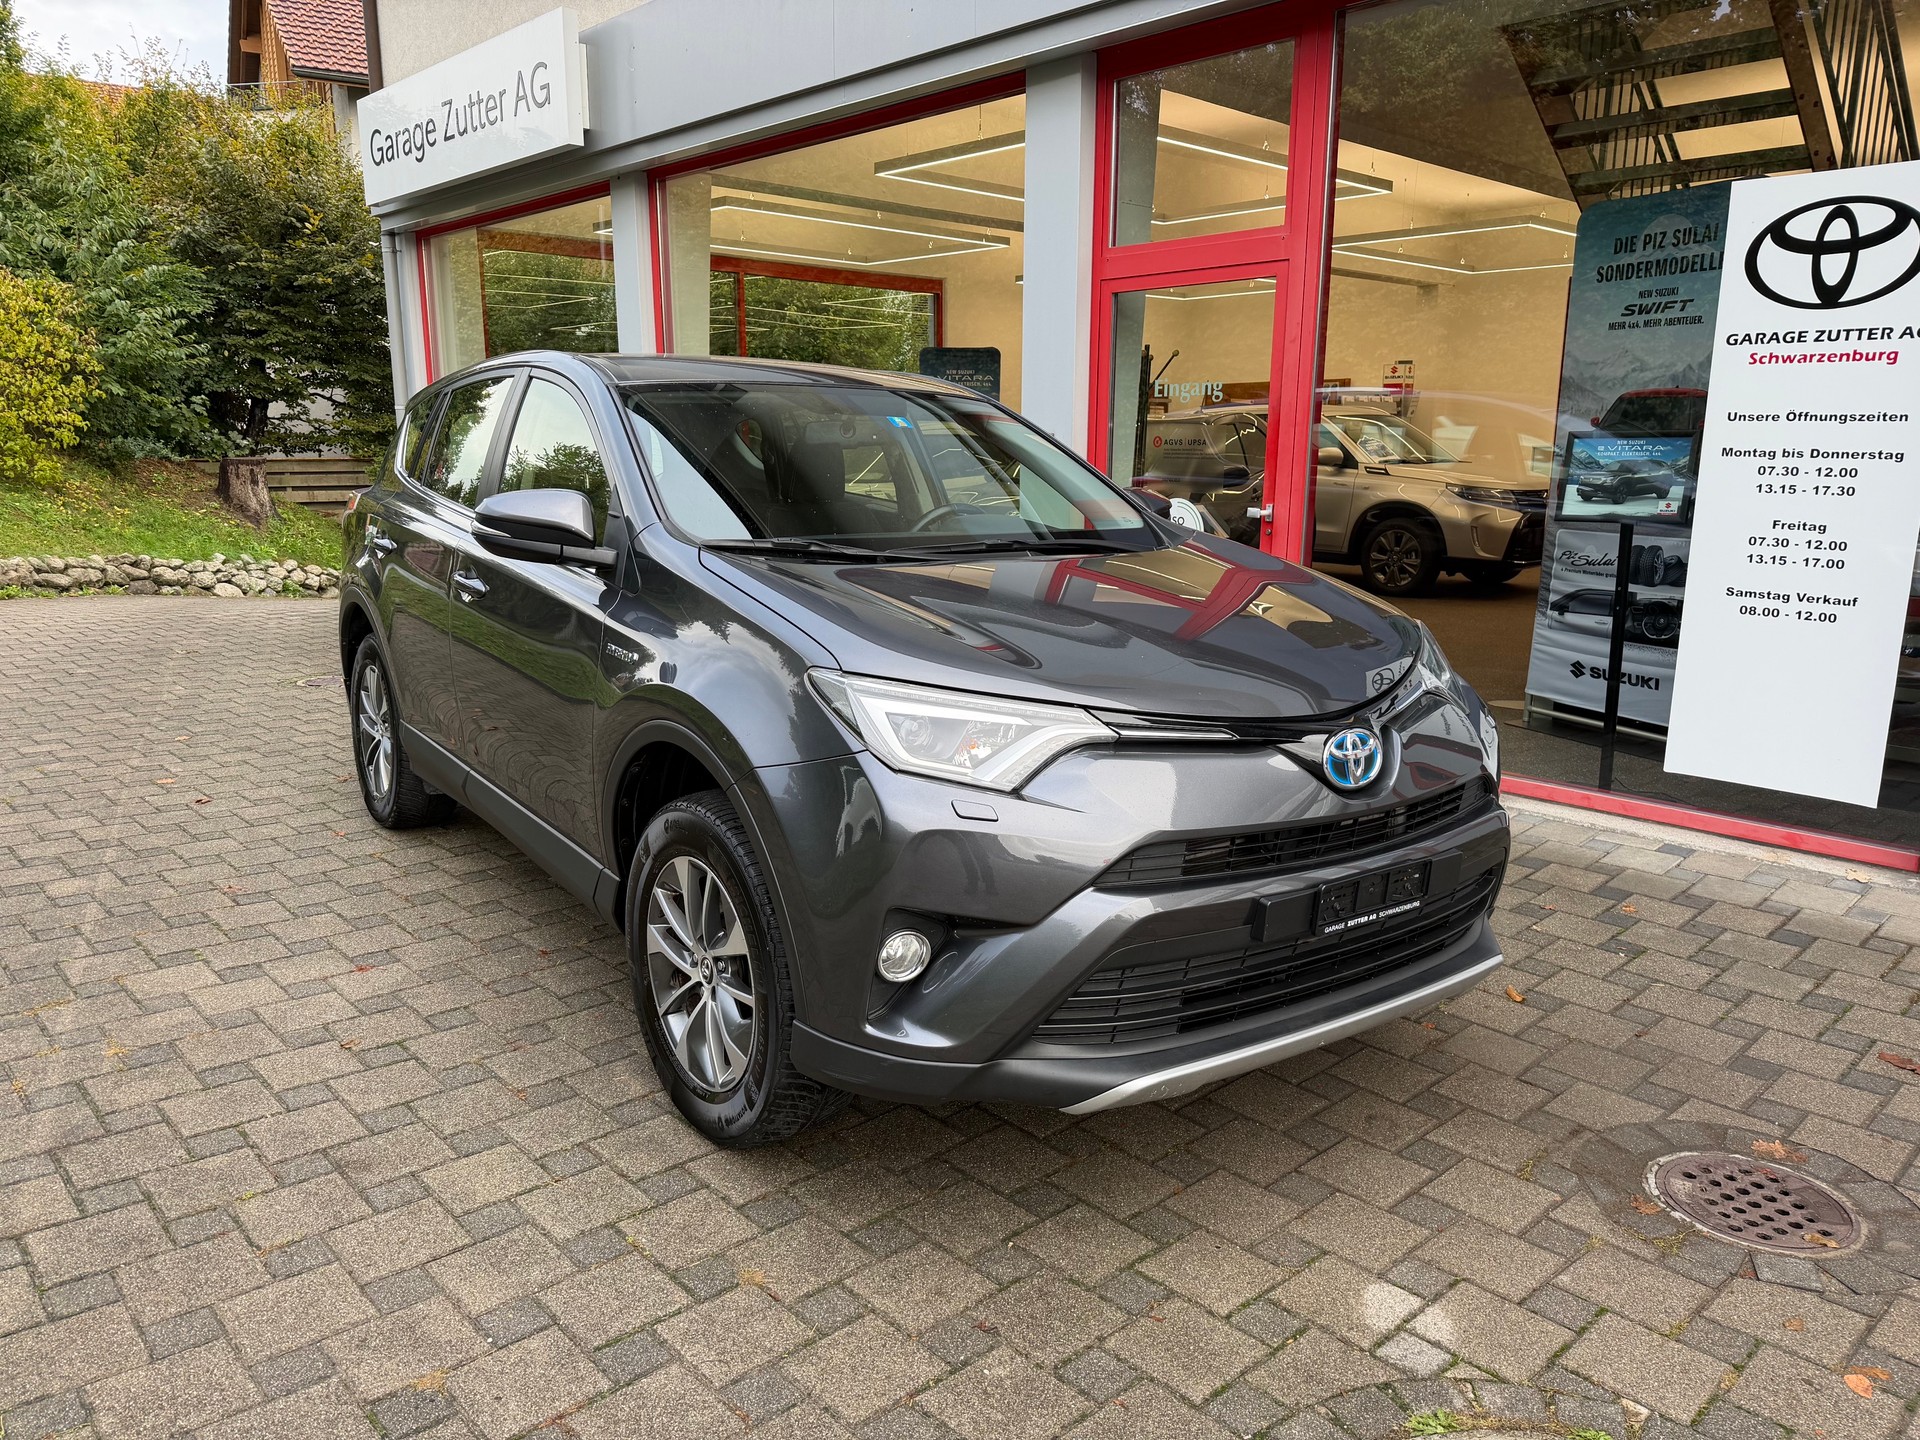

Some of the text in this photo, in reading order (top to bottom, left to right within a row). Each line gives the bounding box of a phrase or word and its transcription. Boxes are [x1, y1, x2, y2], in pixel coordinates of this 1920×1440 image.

[370, 61, 550, 167] Garage Zutter AG
[1614, 223, 1719, 255] DIE PIZ SULAI
[1638, 287, 1679, 299] NEW SUZUKI
[1620, 299, 1694, 317] SWIFT
[1608, 321, 1626, 331] MEHR
[1643, 318, 1662, 328] MEHR
[1664, 315, 1704, 327] ABENTEUER.
[1726, 330, 1809, 346] GARAGE
[1813, 327, 1894, 343] ZUTTER
[1748, 349, 1899, 365] Schwarzenburg
[1154, 378, 1223, 403] Eingang
[1727, 409, 1909, 424] Unsere Öffnungszeiten
[1721, 447, 1905, 463] Montag bis Donnerstag
[1757, 465, 1799, 477] 07.30
[1815, 467, 1858, 478] 12.00
[1755, 483, 1797, 495] 13.15
[1812, 485, 1856, 497] 17.30
[1772, 519, 1827, 534] Freitag
[1748, 536, 1789, 548] 07.30
[1805, 539, 1847, 551] 12.00
[1559, 550, 1619, 566] Piz Sulai
[1746, 553, 1787, 566] 13.15
[1802, 557, 1845, 570] 17.00
[1726, 587, 1858, 607] Samstag Verkauf
[1739, 605, 1780, 618] 08.00
[1795, 610, 1837, 623] 12.00
[1324, 922, 1345, 933] GARAGE
[1347, 915, 1368, 927] ZUTTER
[1378, 900, 1420, 918] SCHWARZENBURG
